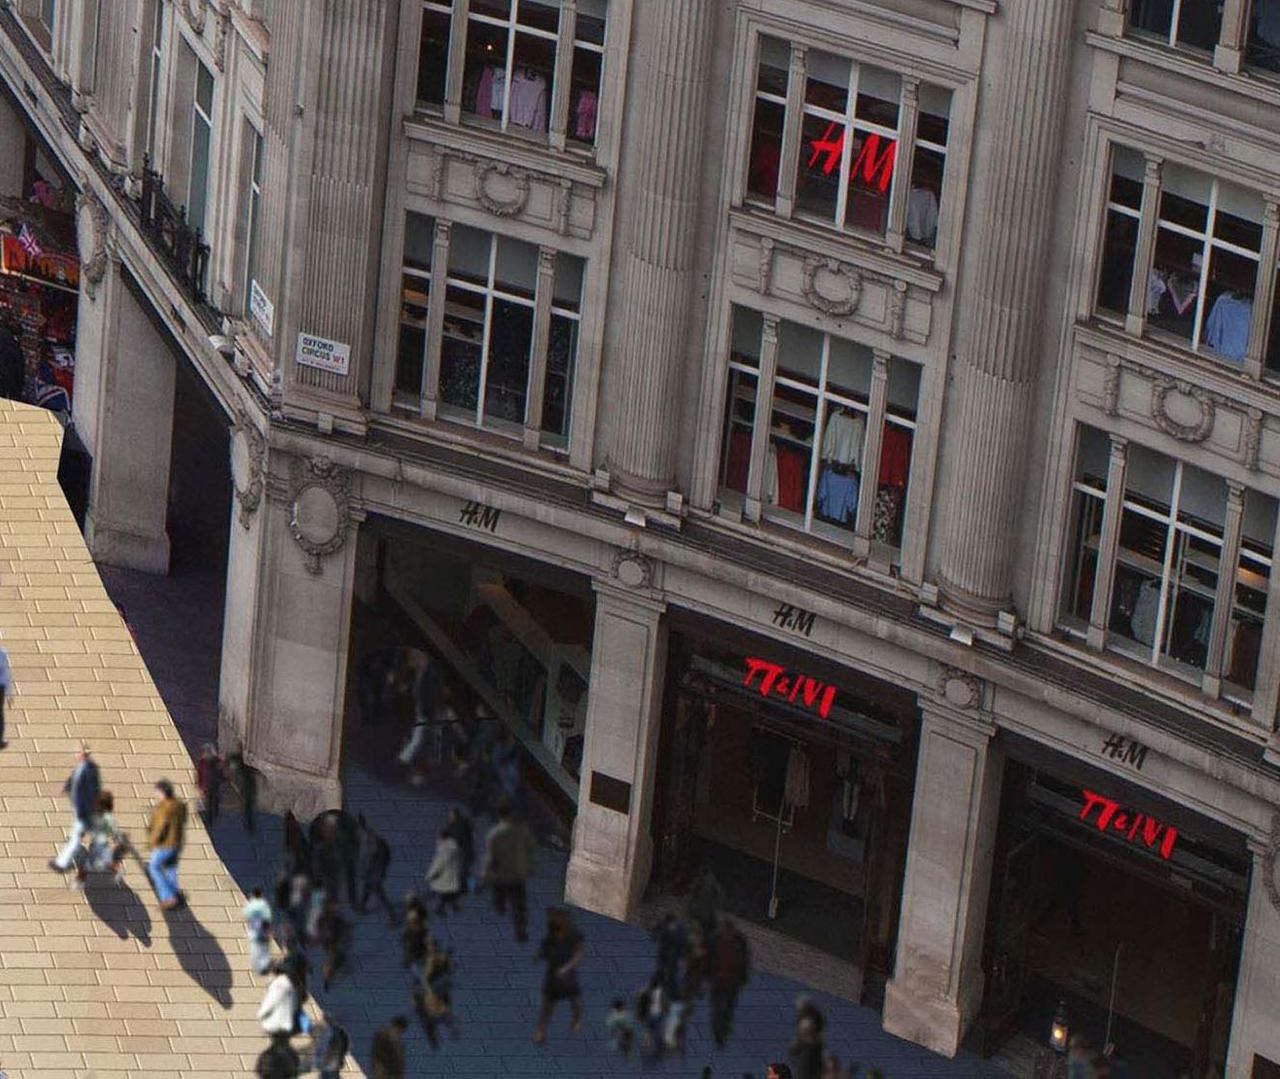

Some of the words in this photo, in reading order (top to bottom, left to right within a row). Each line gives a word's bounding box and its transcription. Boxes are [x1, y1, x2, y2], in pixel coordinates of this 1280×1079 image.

[301, 346, 330, 361] CIRCUS
[302, 337, 334, 352] OXFORD
[772, 602, 817, 637] H&M
[1101, 732, 1150, 771] H&M
